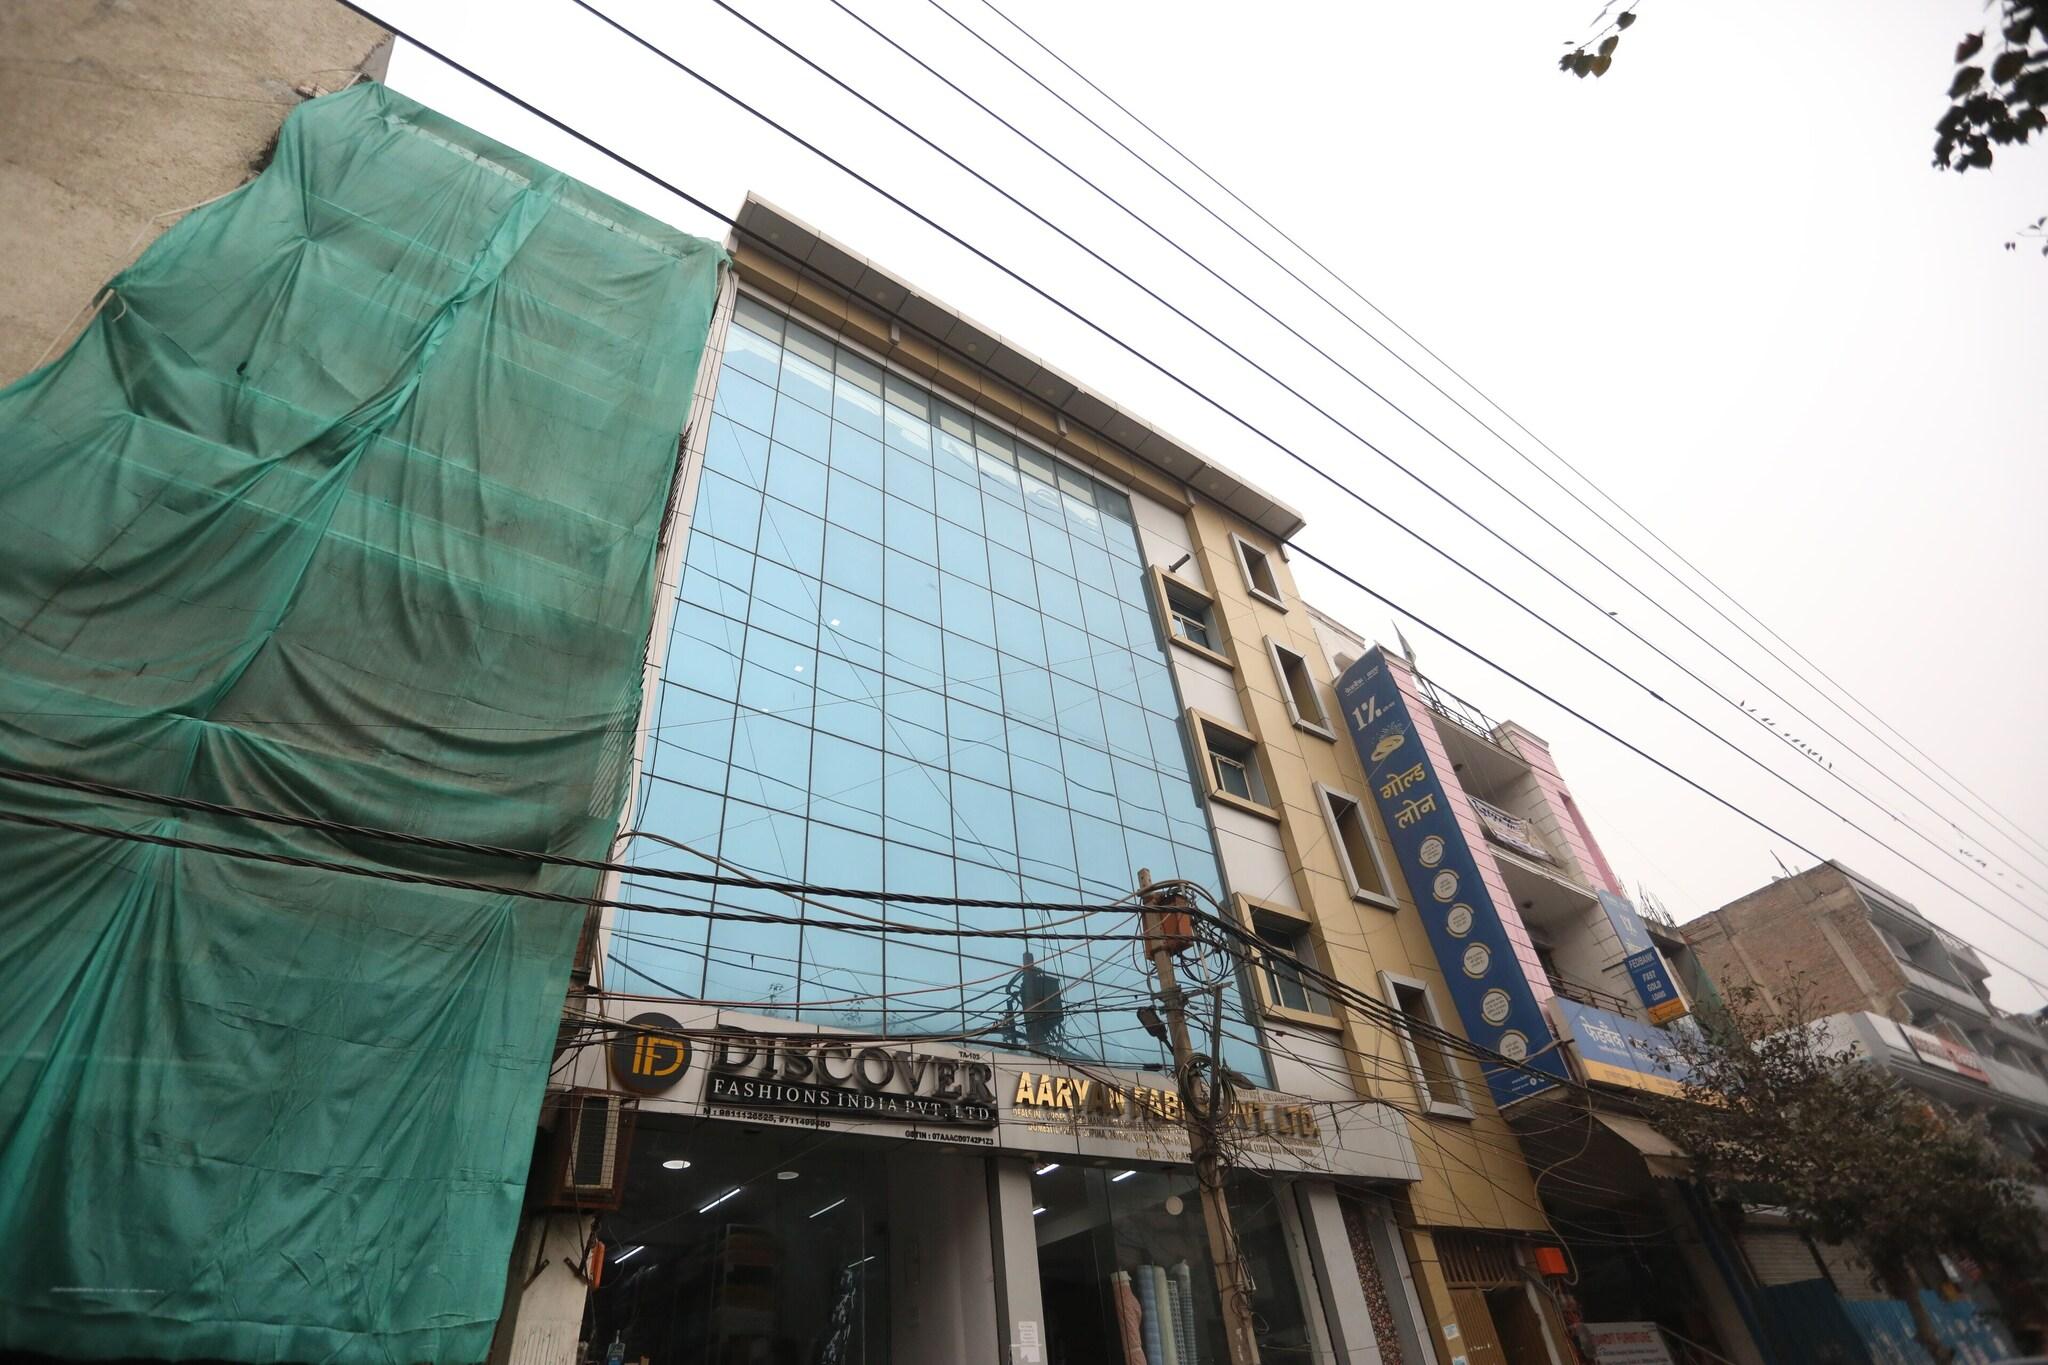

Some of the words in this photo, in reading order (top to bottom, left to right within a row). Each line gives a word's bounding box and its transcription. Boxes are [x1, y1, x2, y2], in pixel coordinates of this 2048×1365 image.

[1380, 762, 1426, 799] गोल्ड
[1395, 793, 1436, 829] लोन
[711, 1024, 997, 1105] DISCOVER
[713, 1079, 830, 1106] FASHIONS
[838, 1093, 898, 1113] INDIA
[905, 1100, 948, 1118] PVT.
[955, 1105, 996, 1121] LTD.
